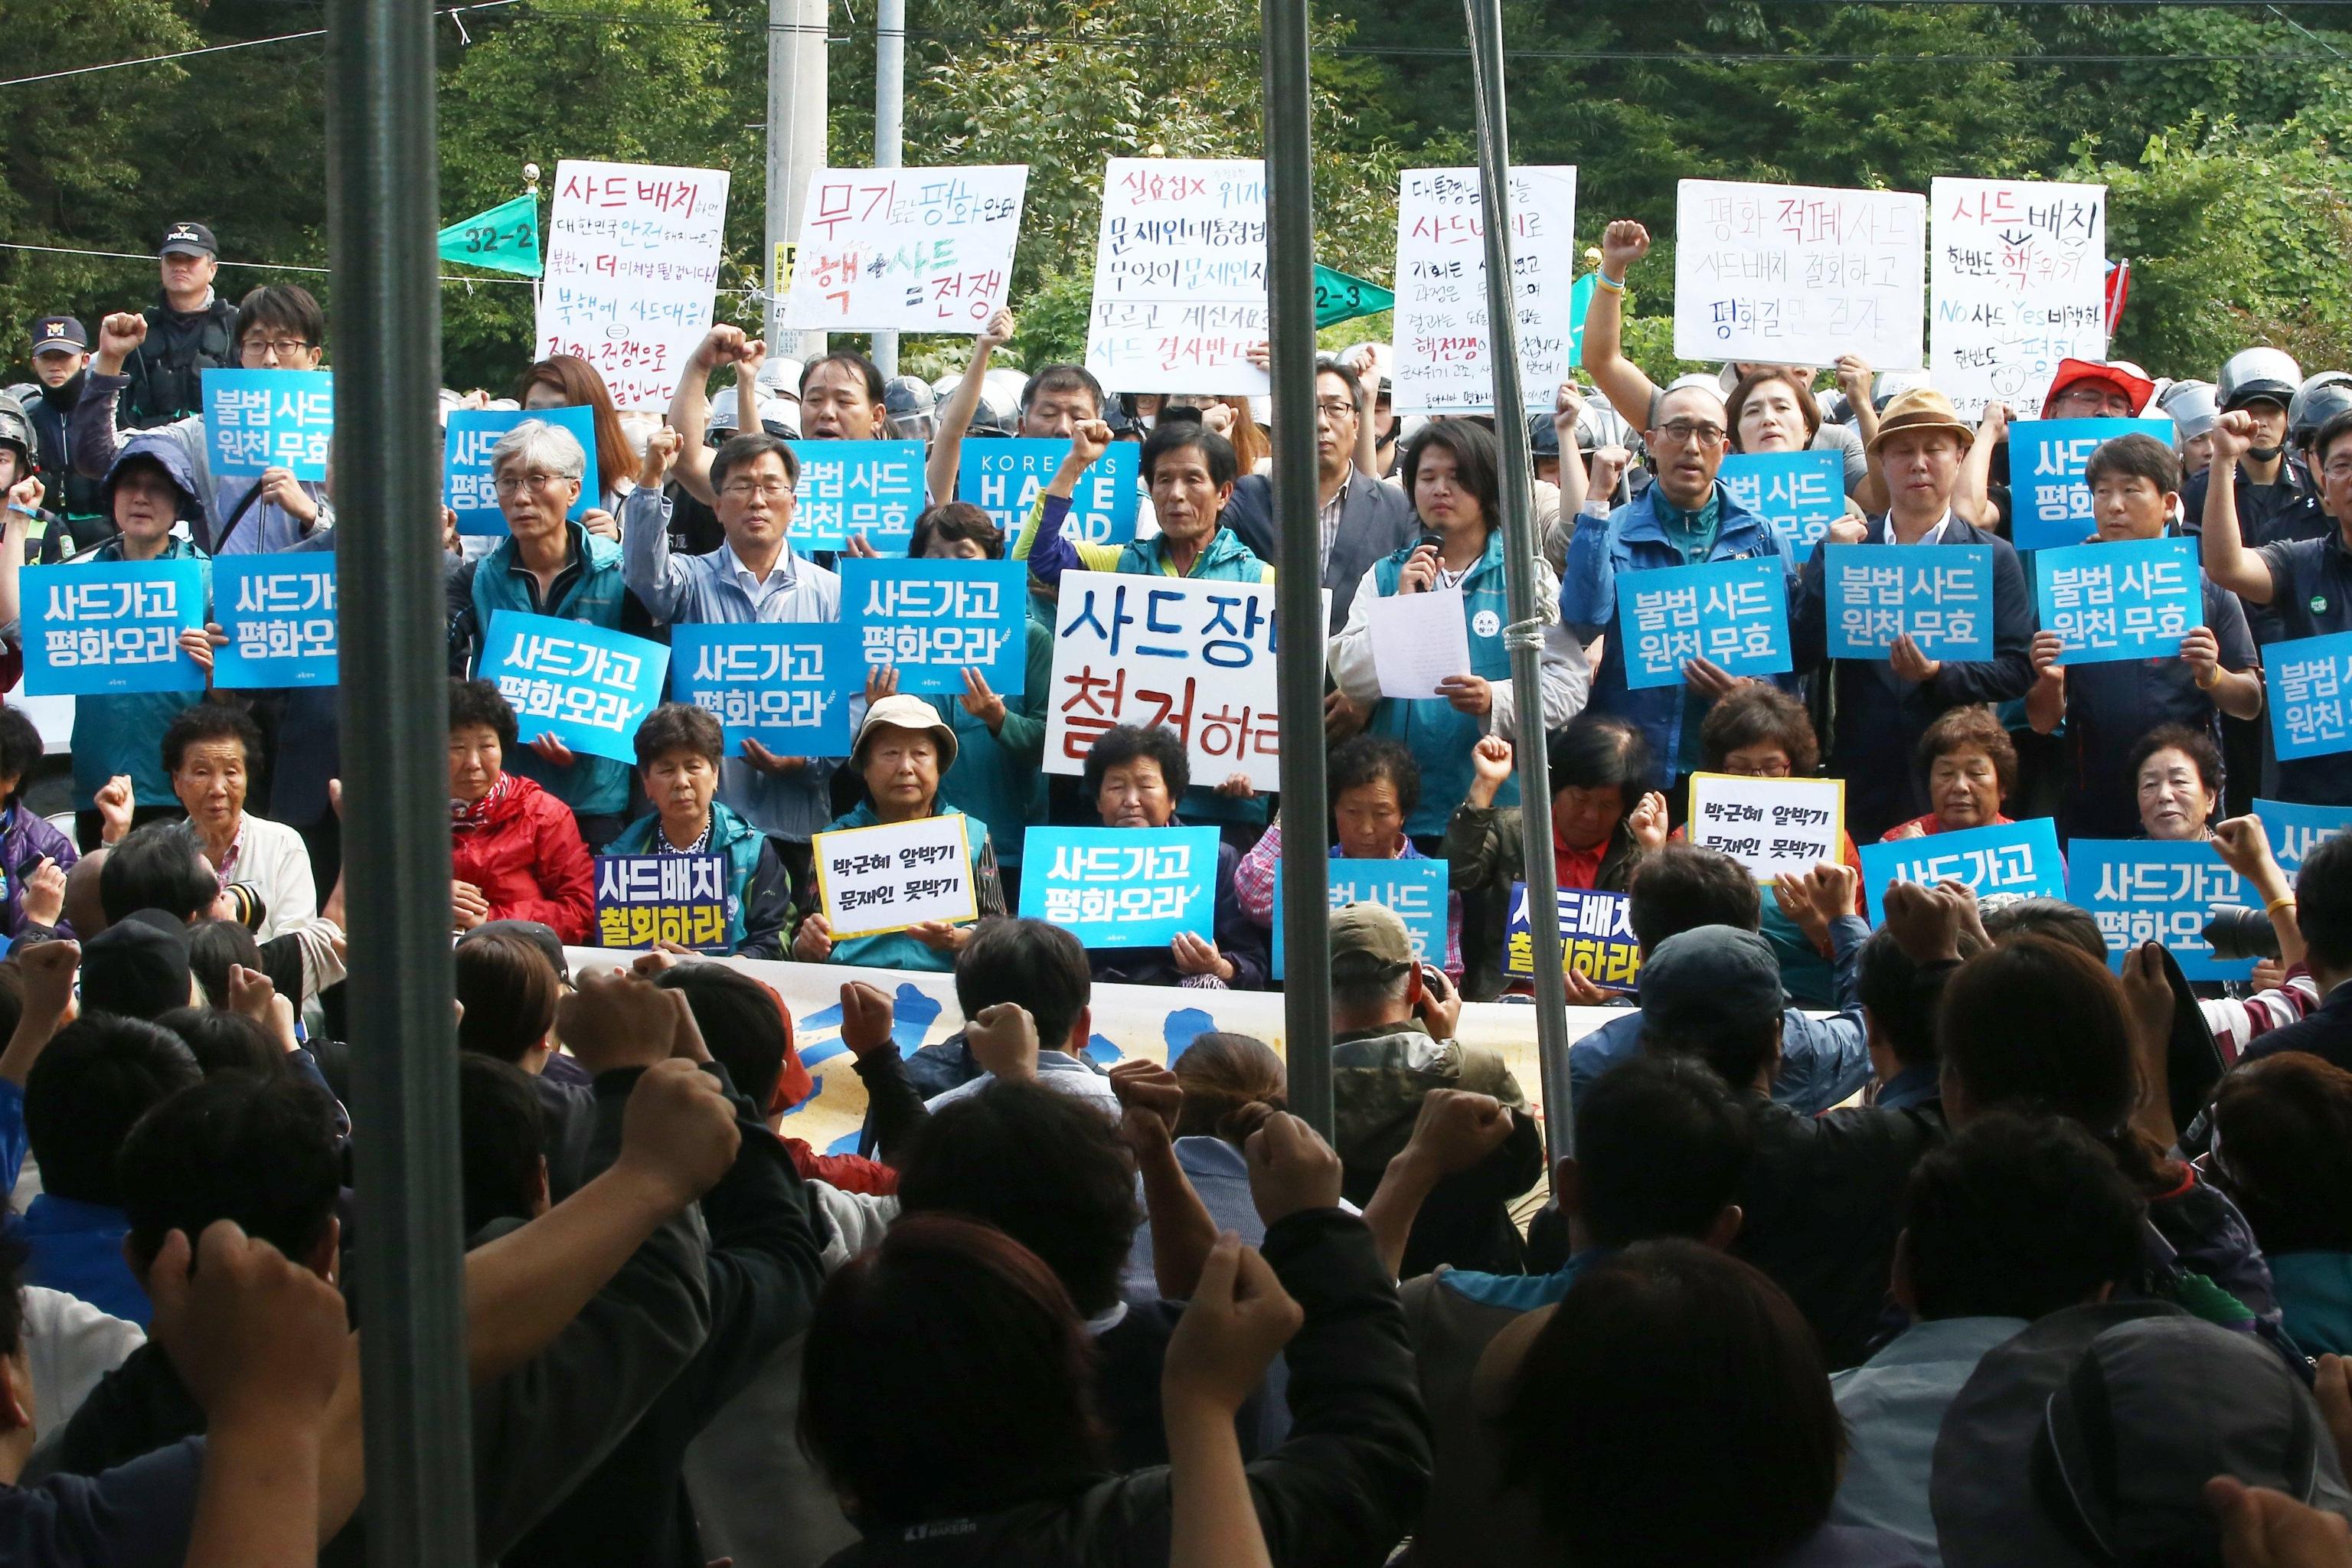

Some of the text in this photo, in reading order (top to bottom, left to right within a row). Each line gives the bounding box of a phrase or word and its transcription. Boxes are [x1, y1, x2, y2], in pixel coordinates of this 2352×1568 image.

[563, 175, 627, 207] 사드
[1217, 181, 1268, 208] 위기
[1952, 191, 2024, 226] 사드
[167, 232, 199, 242] POLICE
[466, 223, 533, 253] 32-2
[1704, 196, 1908, 245] 평화 적폐 사드
[551, 248, 589, 276] 북한이
[596, 254, 617, 277] 더
[1109, 260, 1179, 292] 무엇이
[1804, 251, 1900, 289] 철회하고
[1947, 245, 1997, 276] 한반도
[557, 287, 618, 325] 북핵에
[1099, 303, 1165, 330] 모르고
[1408, 310, 1457, 334] 결과는
[1939, 300, 1968, 323] No
[1971, 303, 2007, 328] 사드
[2012, 301, 2046, 326] Yes
[602, 341, 666, 372] 전쟁으로
[1089, 337, 1146, 367] 사드
[1954, 347, 2003, 371] 한반도
[214, 389, 335, 427] 불법 사드
[217, 430, 330, 469] 원천 무효
[982, 455, 1117, 475] KORENS
[848, 461, 912, 498] 사드
[1723, 472, 1831, 512] 법 사드
[786, 501, 911, 538] 원천 무효
[44, 580, 178, 621] 사드가고
[236, 573, 337, 613] 사드가
[862, 580, 1000, 619] 사드가고
[1838, 565, 1979, 605] 불법 사드
[2050, 561, 2187, 609] 불법 사드
[1633, 581, 1772, 632] 불법 사드
[861, 625, 1002, 665] 평화오라
[1061, 585, 1277, 668] 사드 장
[1841, 609, 1979, 648] 원천 무효
[2050, 603, 2191, 652] 원천 무효
[44, 626, 181, 667] 평화오라
[503, 632, 642, 692] 사드가고
[692, 644, 825, 681] 사드가고
[1638, 622, 1777, 674] 원천 무효
[2278, 655, 2340, 703] 불법
[498, 675, 634, 733] 평화오라
[692, 689, 827, 727] 평화오라
[2285, 699, 2346, 745] 원천
[1704, 802, 1829, 826] 박근혜 알박기
[833, 844, 956, 877] 박근혜 알박기
[1046, 844, 1191, 881] 사드가고
[1769, 838, 1827, 859] 못박기
[599, 857, 724, 902] 사드배치
[838, 877, 959, 911] 문재인 못박기
[2093, 863, 2242, 902] 사드가고
[1044, 883, 1191, 923] 평화오라
[599, 905, 726, 947] 철회하라
[2093, 909, 2216, 951] 평화오
